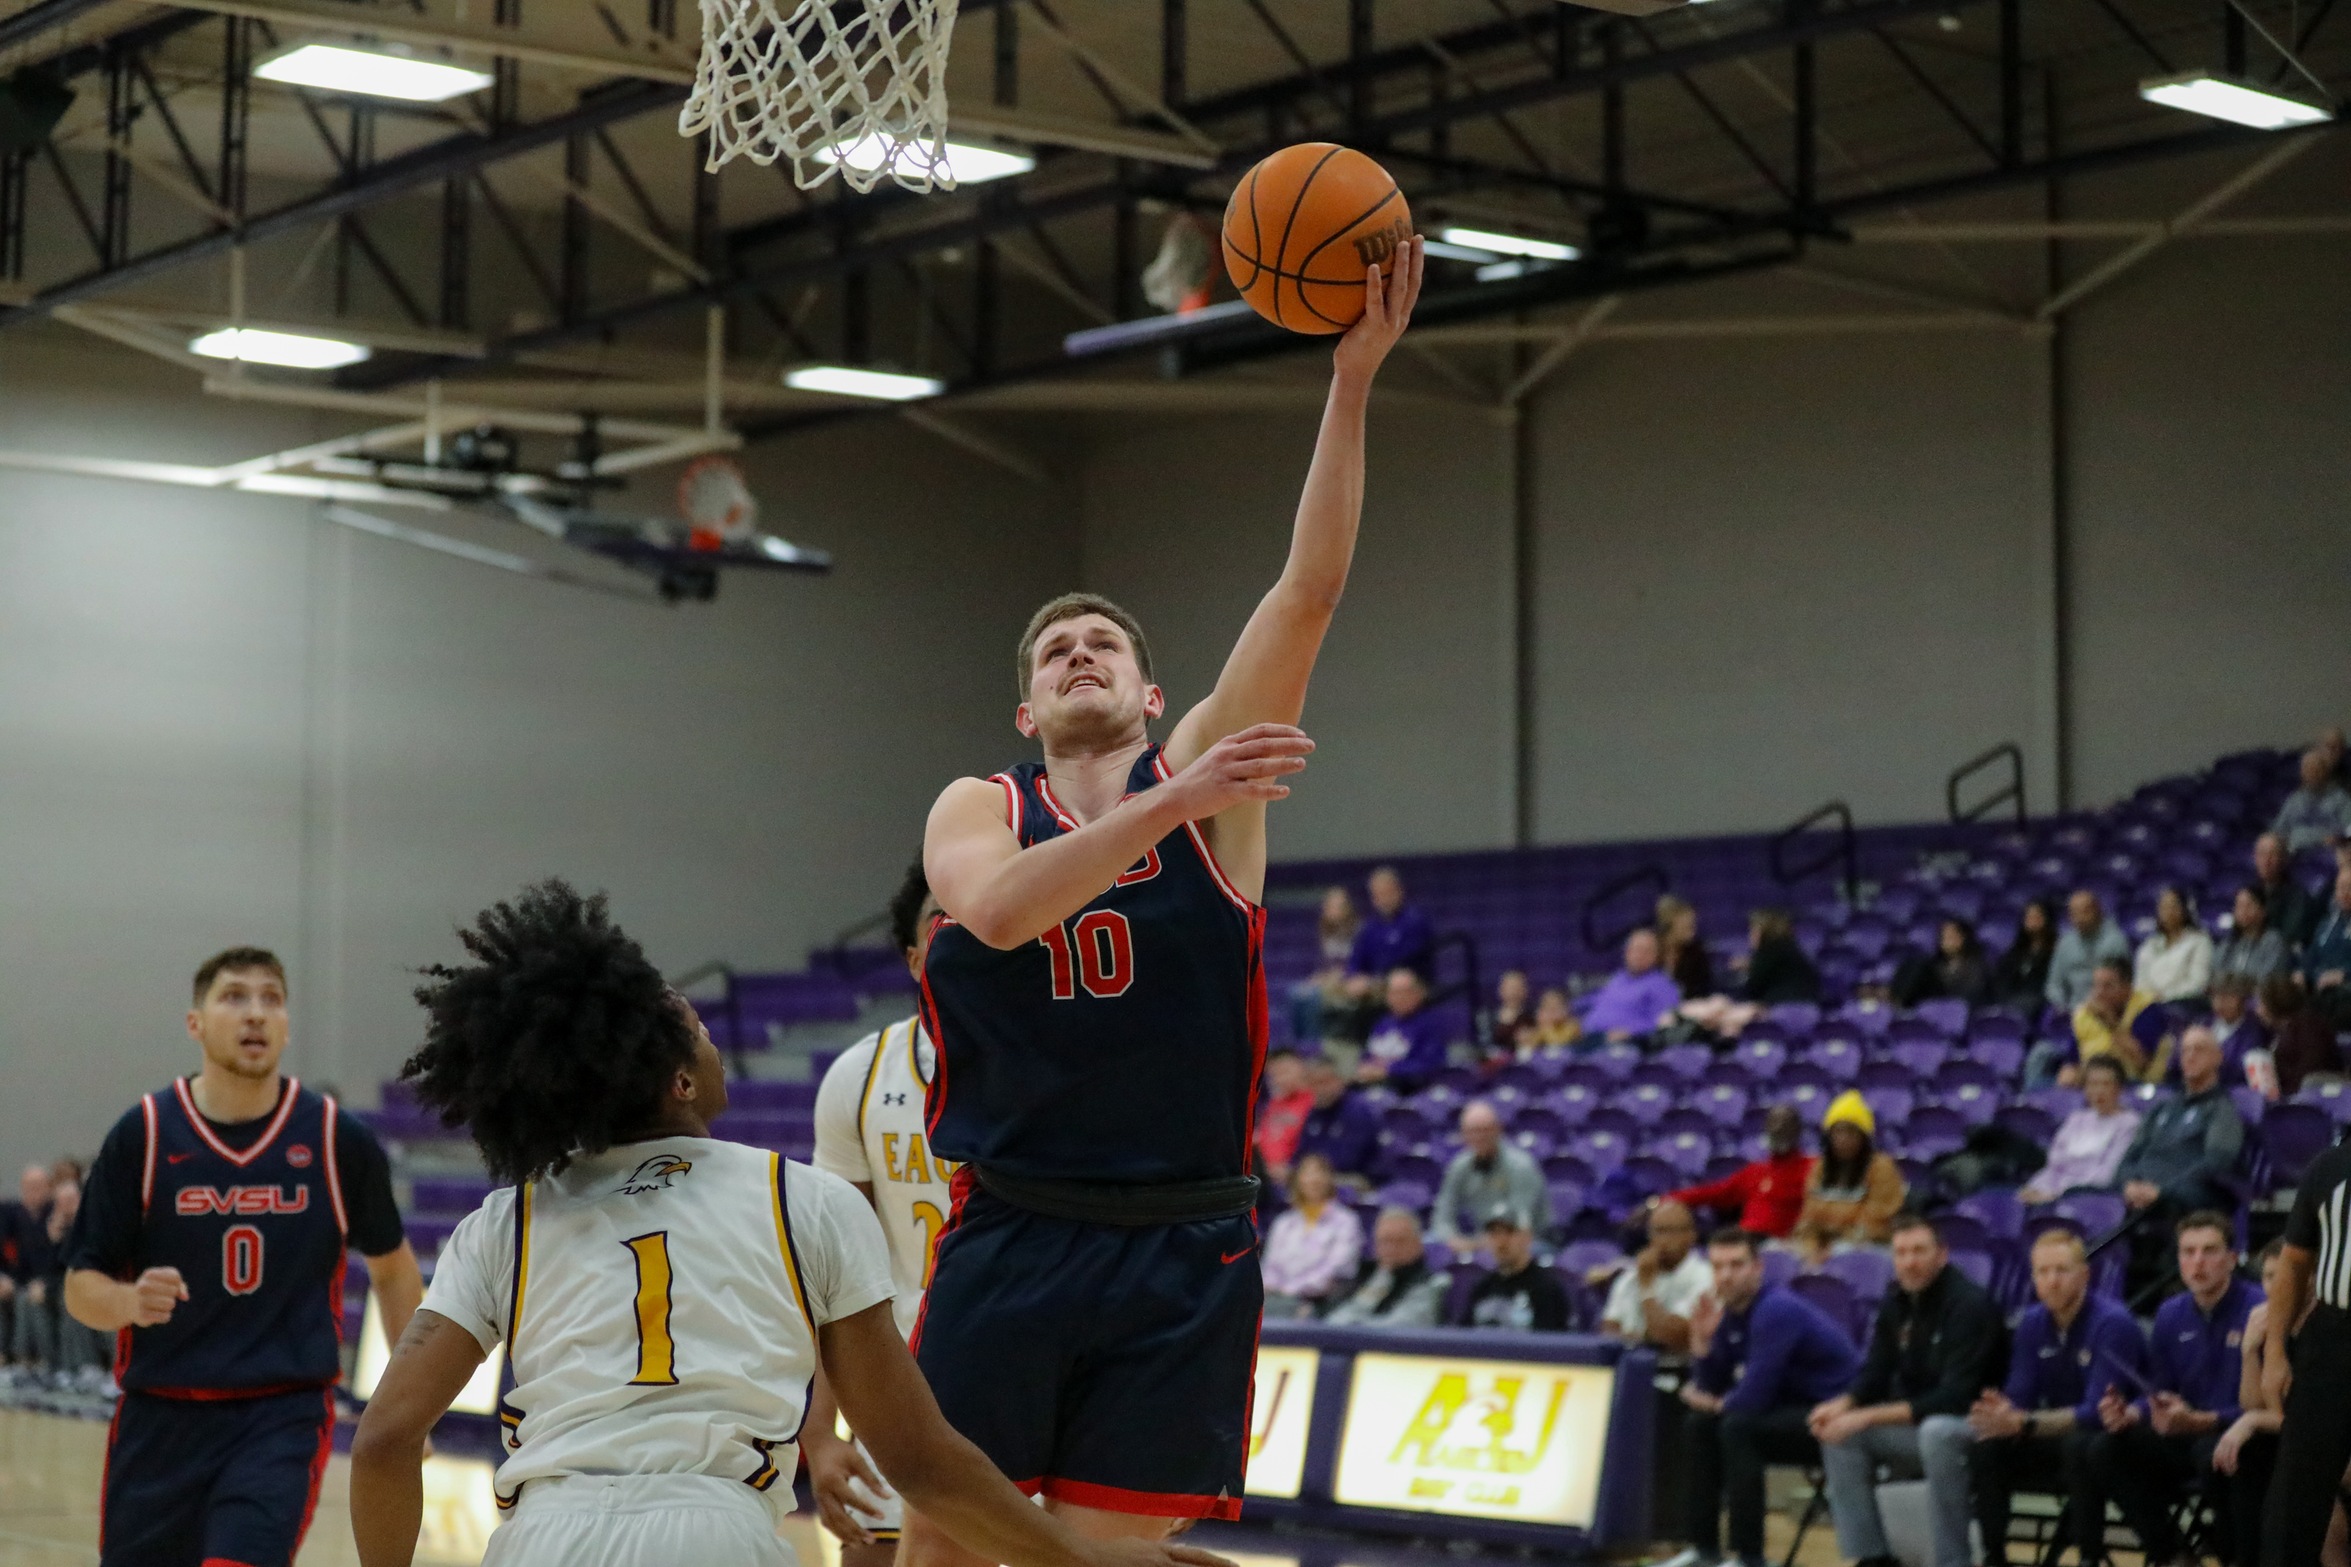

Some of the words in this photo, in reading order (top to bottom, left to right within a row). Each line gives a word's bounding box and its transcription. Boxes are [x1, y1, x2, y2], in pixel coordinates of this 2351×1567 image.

[1038, 908, 1134, 1000] 10
[175, 1183, 309, 1215] SVSU
[222, 1223, 264, 1296] 0
[619, 1230, 680, 1386] 1
